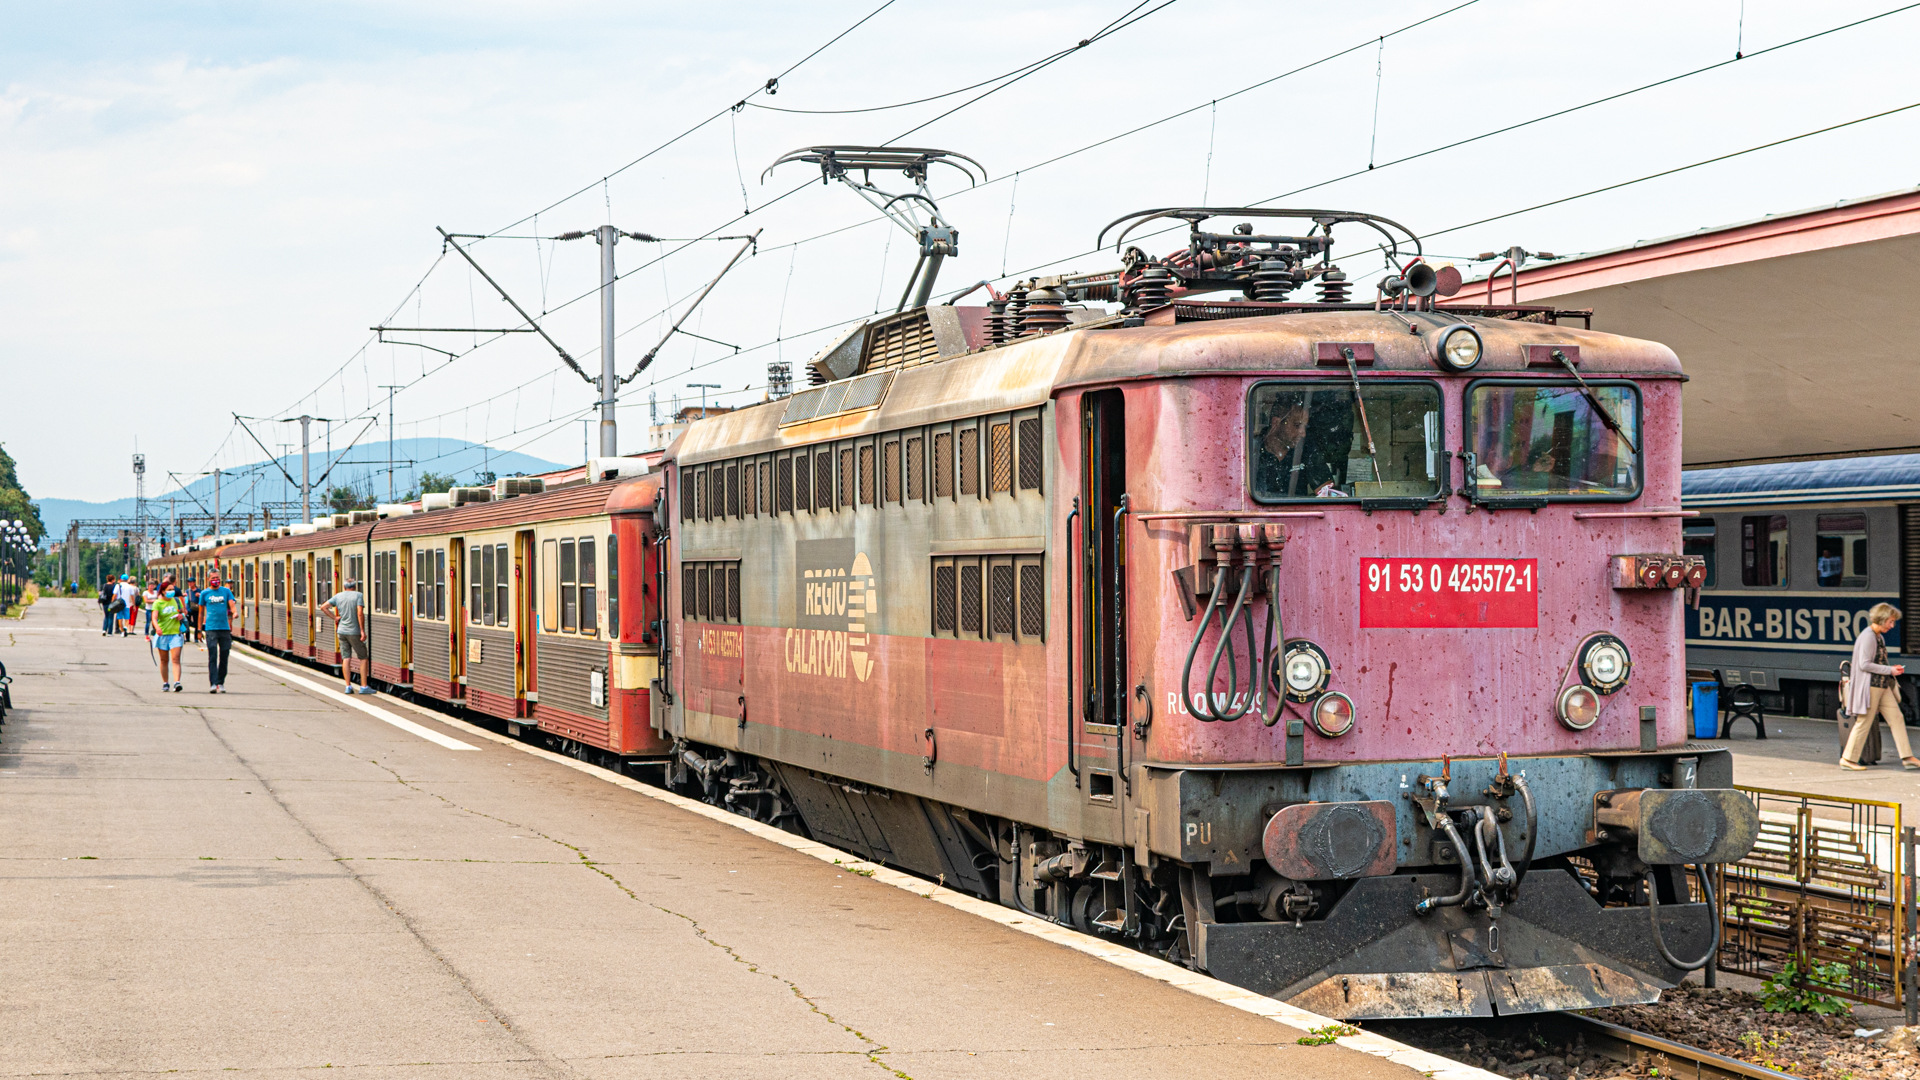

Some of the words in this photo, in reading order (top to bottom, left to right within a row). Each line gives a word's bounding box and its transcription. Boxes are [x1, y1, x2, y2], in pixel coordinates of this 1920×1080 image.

[804, 567, 847, 616] REGIO
[1368, 563, 1391, 593] 91
[1399, 563, 1423, 592] 53
[1430, 563, 1443, 592] 0
[1448, 563, 1533, 593] 425572-1
[1699, 607, 1871, 641] BAR-BISTRO
[1185, 822, 1212, 845] PU
